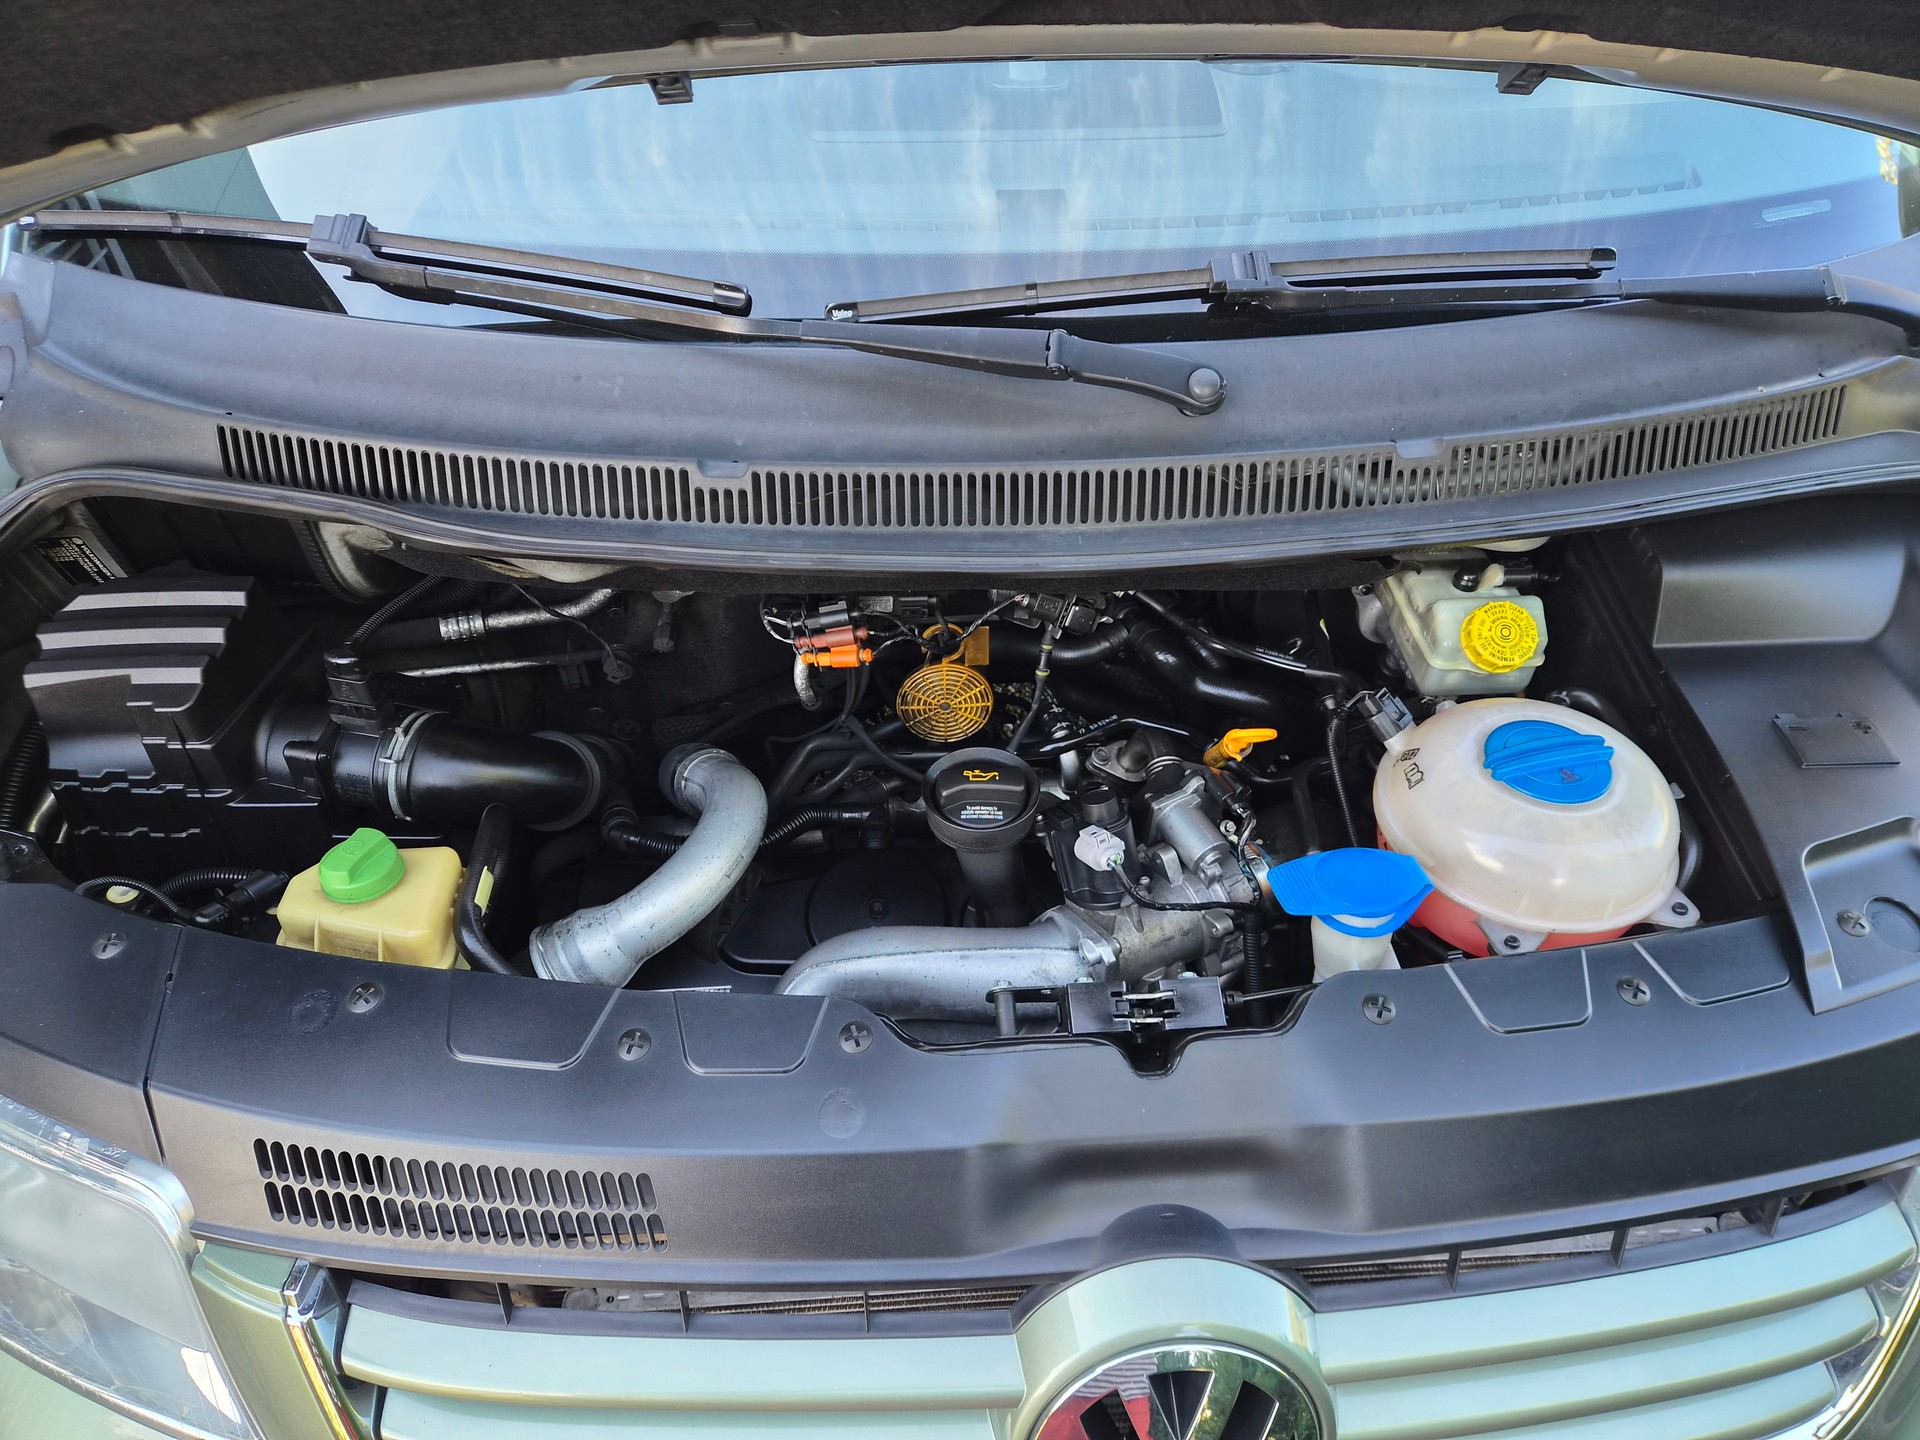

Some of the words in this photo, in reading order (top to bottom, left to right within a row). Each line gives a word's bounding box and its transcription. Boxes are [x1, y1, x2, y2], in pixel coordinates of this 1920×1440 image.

[832, 309, 853, 318] Valeo
[81, 544, 113, 577] VOLKSWAGEN
[1484, 603, 1507, 615] WARNING
[1509, 605, 1524, 615] CLEAN
[1525, 615, 1535, 631] FILLER
[1488, 652, 1515, 662] REMOVING
